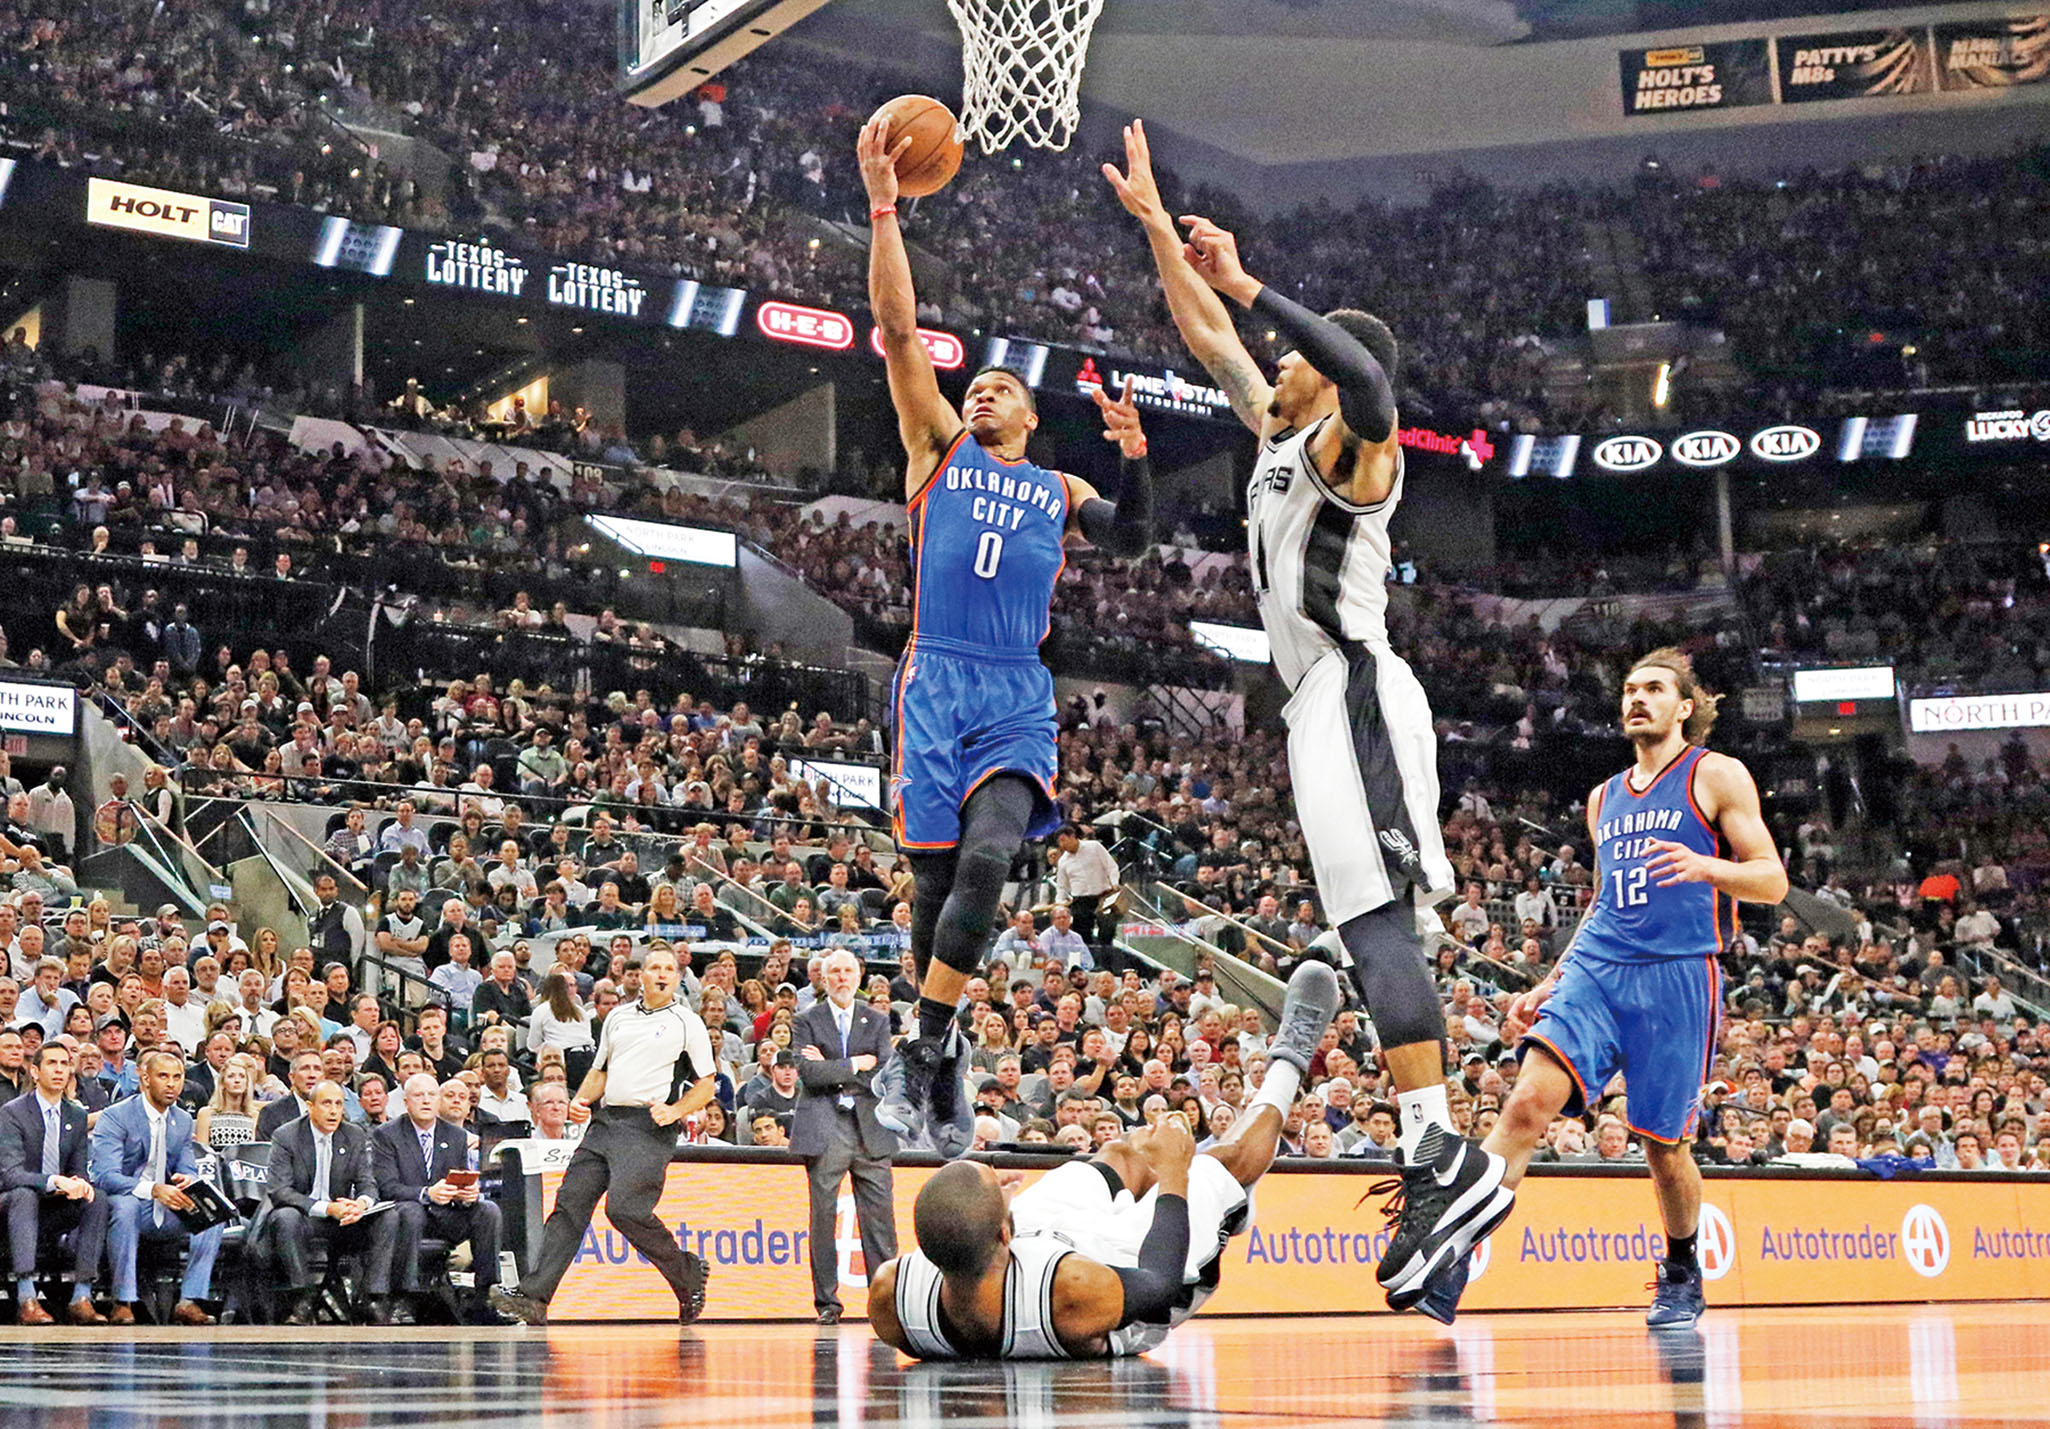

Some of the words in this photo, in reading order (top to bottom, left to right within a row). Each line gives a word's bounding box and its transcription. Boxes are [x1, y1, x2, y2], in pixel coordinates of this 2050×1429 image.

[1794, 45, 1876, 66] PATTY'S
[1637, 65, 1715, 89] HOLT'S
[1634, 84, 1722, 110] HEROES
[110, 195, 199, 223] HOLT
[211, 209, 248, 235] CAT
[446, 240, 505, 269] TEXAS
[427, 252, 525, 296] LOTTERY
[566, 262, 623, 290] TEXAS
[549, 273, 644, 316] LOTTERY
[1111, 370, 1166, 396] LONE
[1761, 432, 1809, 454] KIA
[1967, 419, 2031, 441] LUCKY
[1605, 442, 1652, 465] KIA
[1684, 437, 1730, 459] KIA
[946, 465, 1062, 521] OKLAHOMA
[972, 496, 1026, 531] CITY
[667, 531, 696, 544] PARK
[973, 530, 1004, 579] 0
[25, 693, 69, 710] PARK
[1924, 702, 2019, 725] NORTH
[842, 773, 876, 787] PARK
[1597, 808, 1684, 848] OKLAHOMA
[1611, 866, 1649, 910] 12
[574, 1218, 809, 1265] Autrader
[1761, 1223, 1898, 1261] Autotrader
